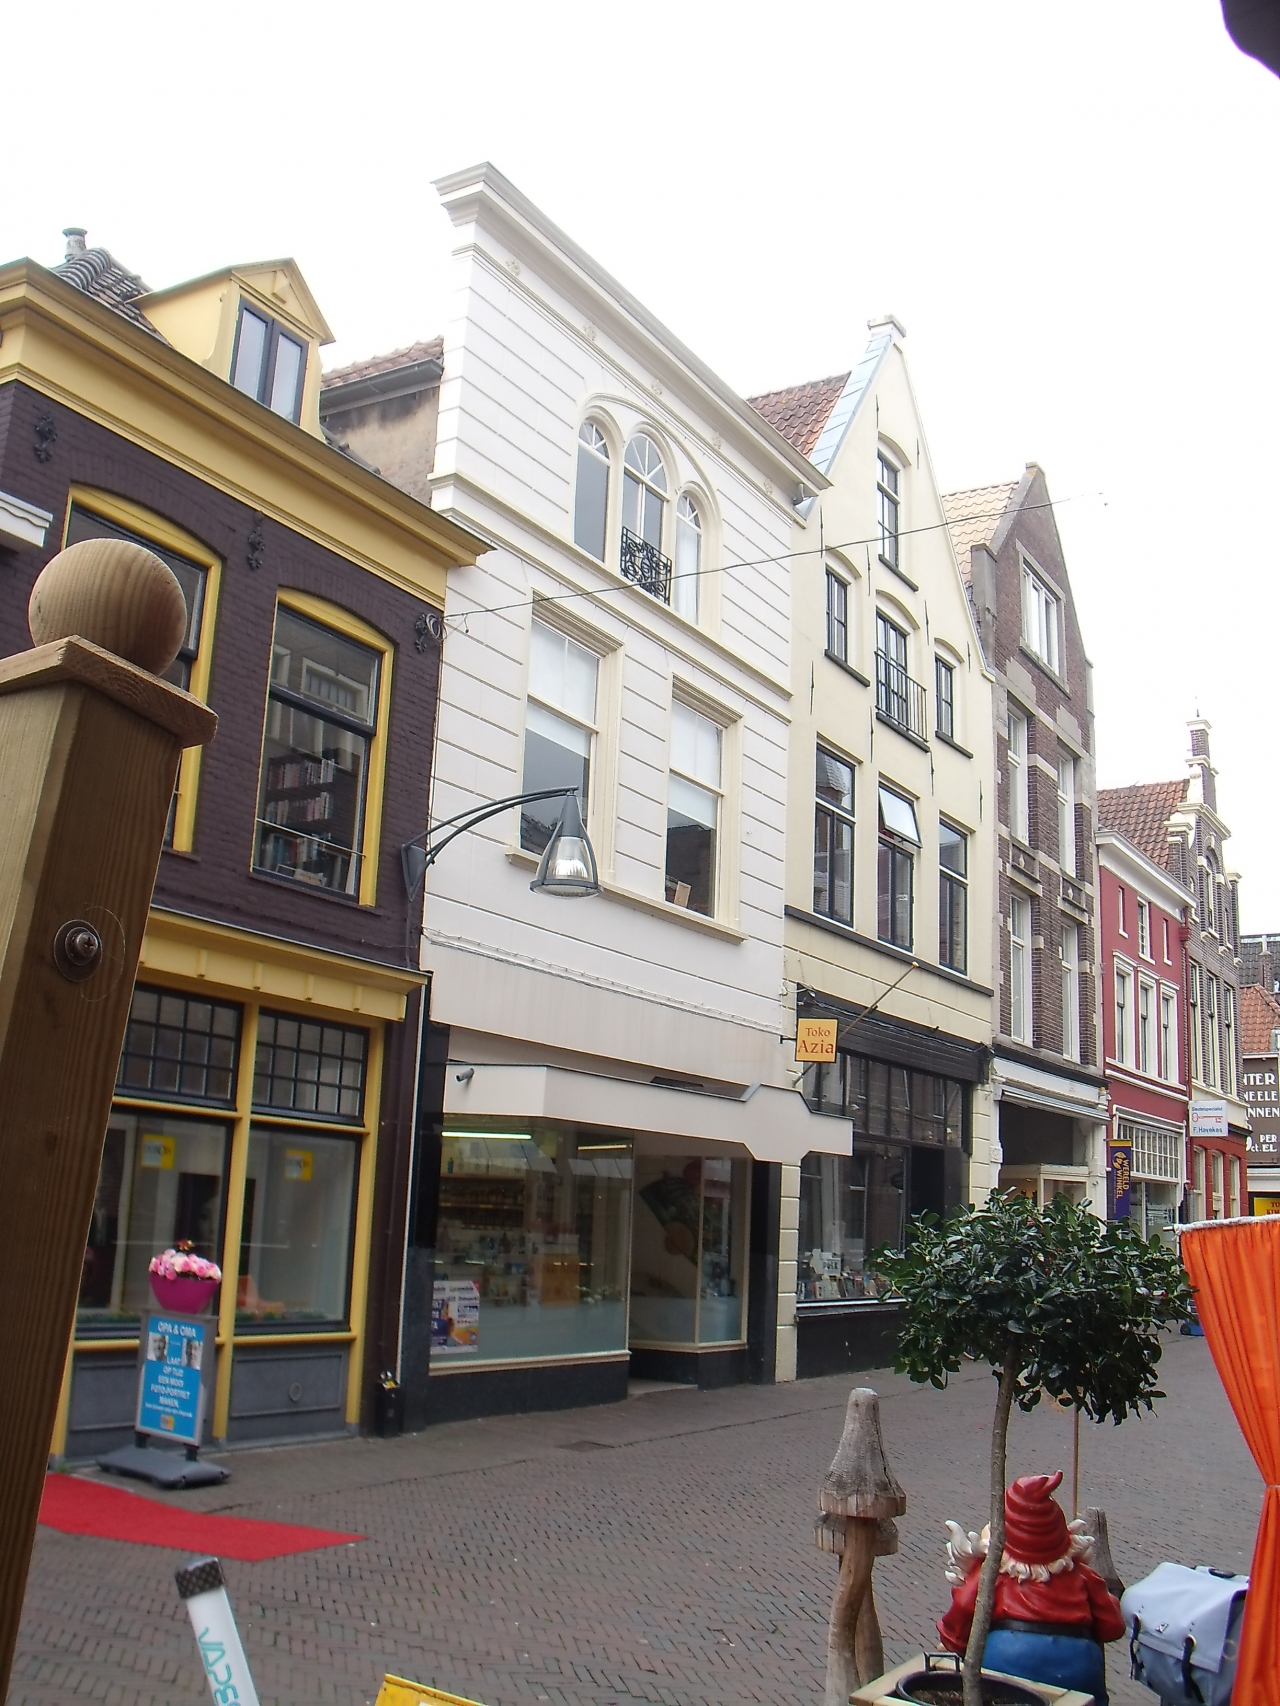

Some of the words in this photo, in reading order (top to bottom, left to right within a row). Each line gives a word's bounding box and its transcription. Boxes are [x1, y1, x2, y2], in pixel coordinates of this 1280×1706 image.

[805, 1026, 831, 1037] Toko
[797, 1039, 834, 1054] Azia
[1259, 1134, 1278, 1143] PER
[1122, 1159, 1130, 1190] WERELD
[1116, 1169, 1124, 1199] WINKEL
[158, 1321, 172, 1333] OPA
[173, 1324, 179, 1335] &
[180, 1325, 196, 1338] OMA
